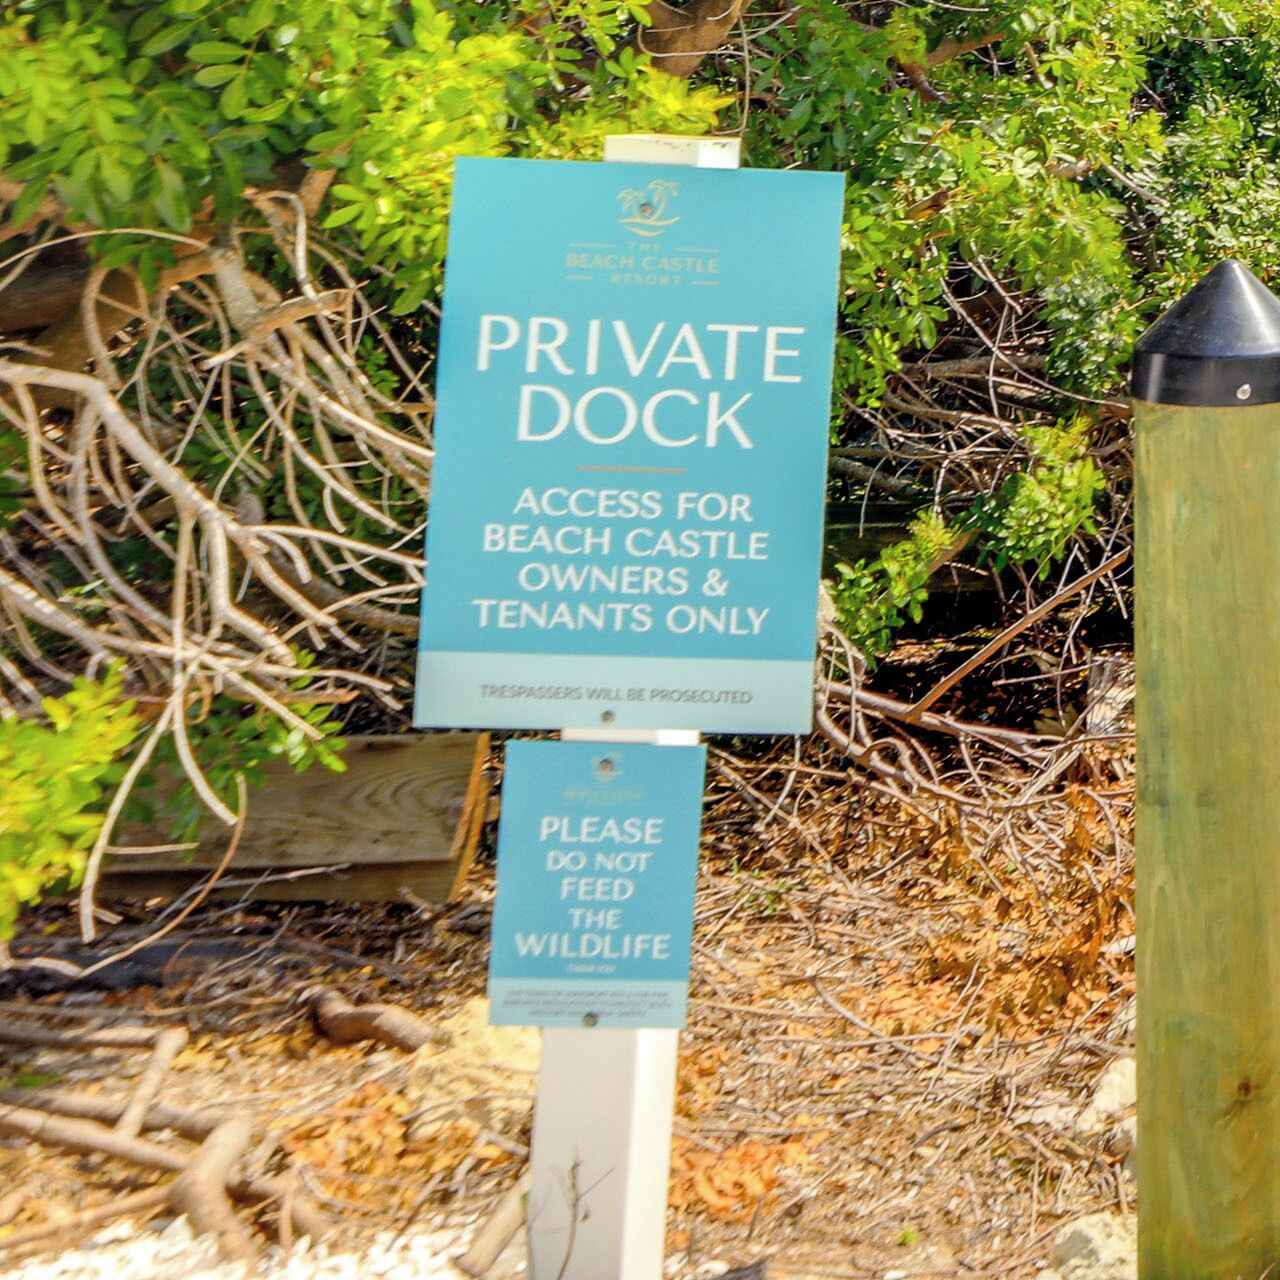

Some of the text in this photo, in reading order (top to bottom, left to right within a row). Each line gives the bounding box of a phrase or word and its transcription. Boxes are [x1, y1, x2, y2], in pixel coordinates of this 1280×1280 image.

[566, 253, 720, 273] BEACH CASTLE
[611, 272, 682, 286] RESORT
[477, 314, 805, 383] PRIVATE
[517, 384, 753, 449] DOCK
[513, 487, 753, 522] ACCESS FOR
[483, 524, 769, 560] BEACH CASTLE
[518, 562, 729, 597] OWNERS &
[472, 599, 769, 635] TENANTS ONLY
[480, 684, 754, 704] TRESPASSERS WILL BE PROSECUTED
[540, 816, 664, 845] PLEASE
[546, 851, 654, 873] DO NOT
[560, 878, 635, 901] FEED
[568, 908, 623, 930] THE
[515, 933, 672, 960] WILDLIFE
